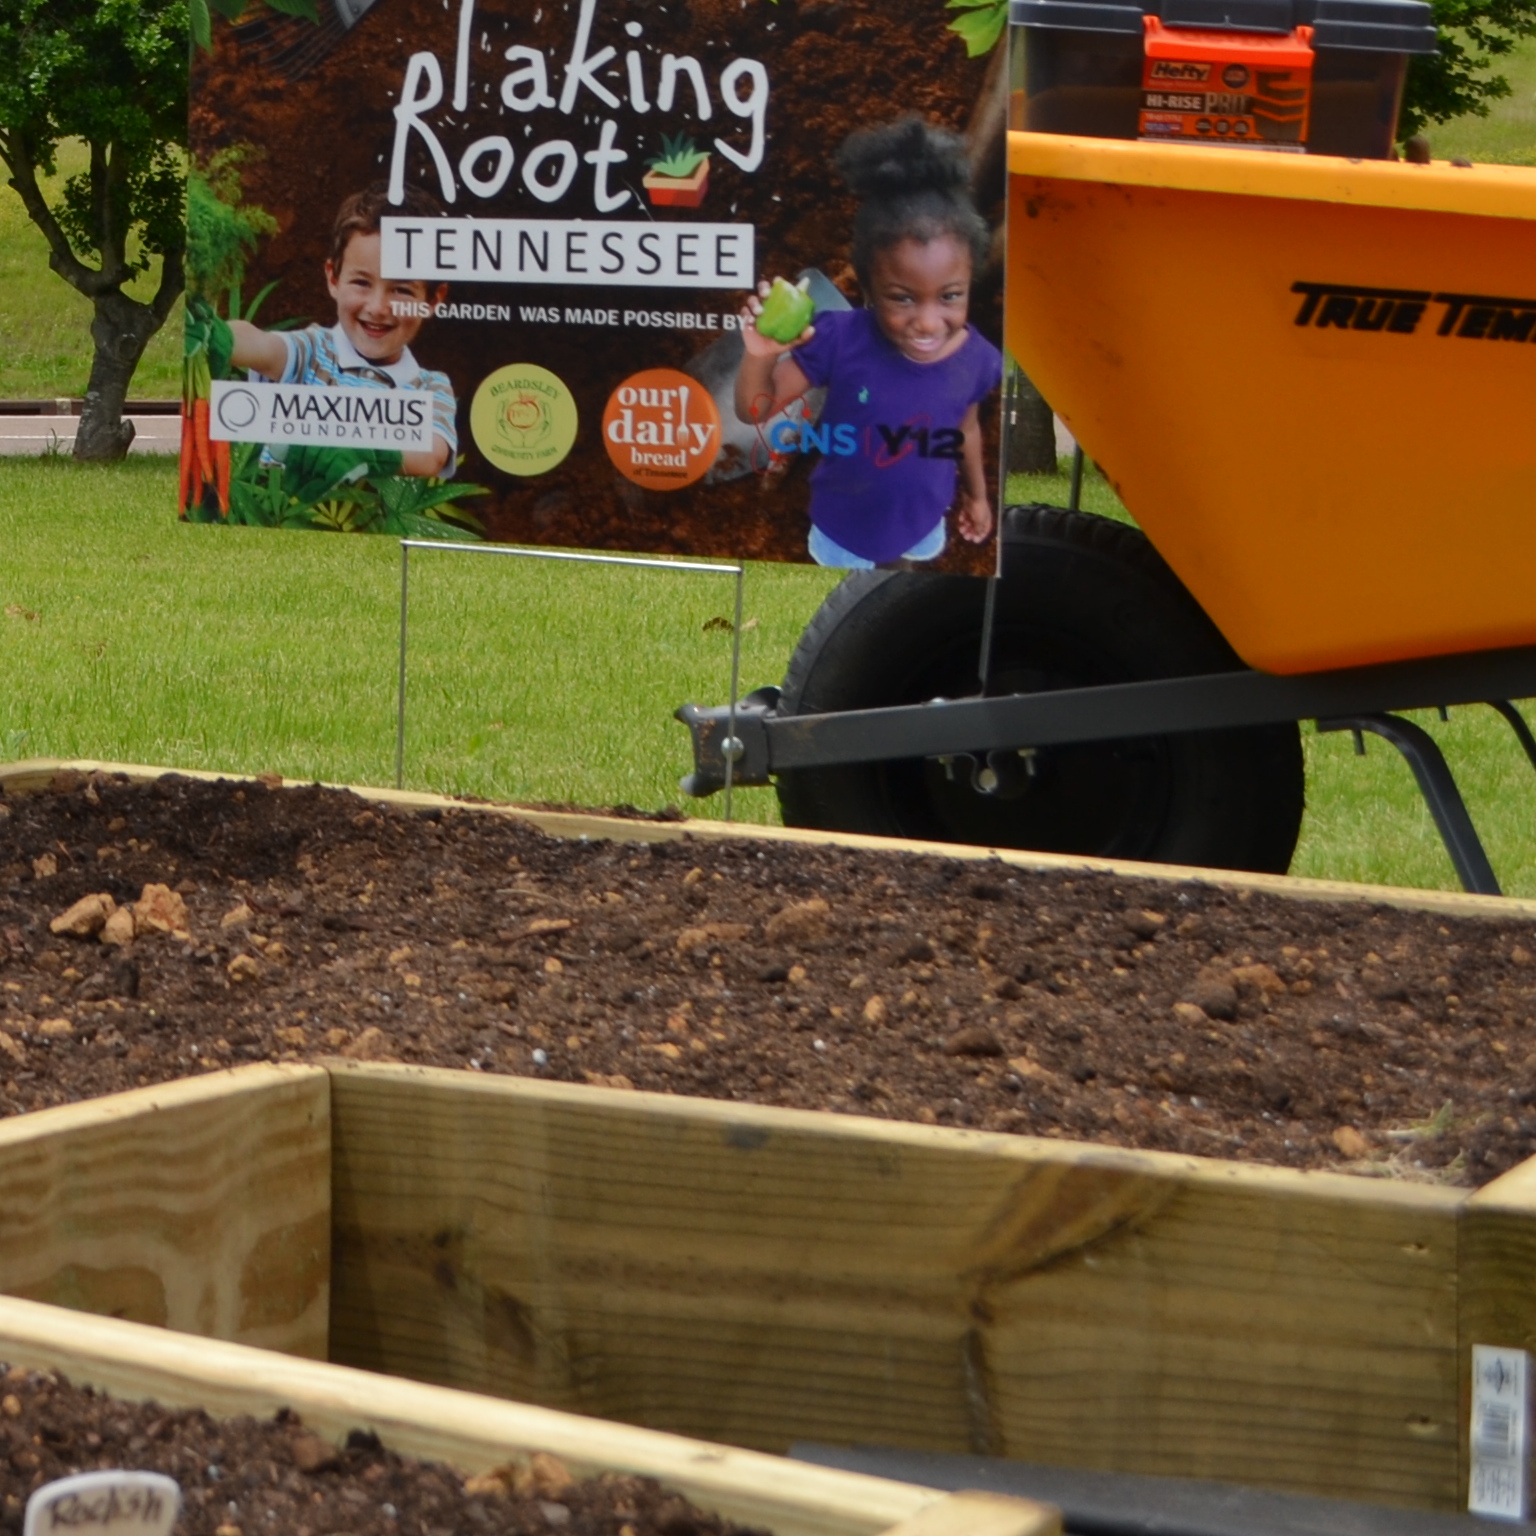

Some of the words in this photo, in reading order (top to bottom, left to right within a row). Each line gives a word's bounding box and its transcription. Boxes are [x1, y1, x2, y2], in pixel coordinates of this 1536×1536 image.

[1153, 63, 1209, 81] Hefty
[1146, 94, 1203, 110] HI-RISE
[388, 51, 632, 213] Root
[394, 227, 739, 277] TENNESSEE
[390, 300, 430, 319] THIS
[435, 302, 511, 322] GARDEN
[519, 306, 561, 324] WAS
[564, 307, 620, 326] MADE
[623, 310, 720, 330] POSSIBLE
[1290, 281, 1432, 334] TRUE
[1433, 292, 1536, 344] TEM
[490, 378, 561, 400] BEARDSLEY
[617, 385, 679, 408] our
[271, 393, 425, 427] MAXIMUS
[270, 421, 424, 442] FOUNDATION
[607, 408, 716, 456] daily
[769, 420, 858, 457] CNS
[630, 447, 688, 468] bread
